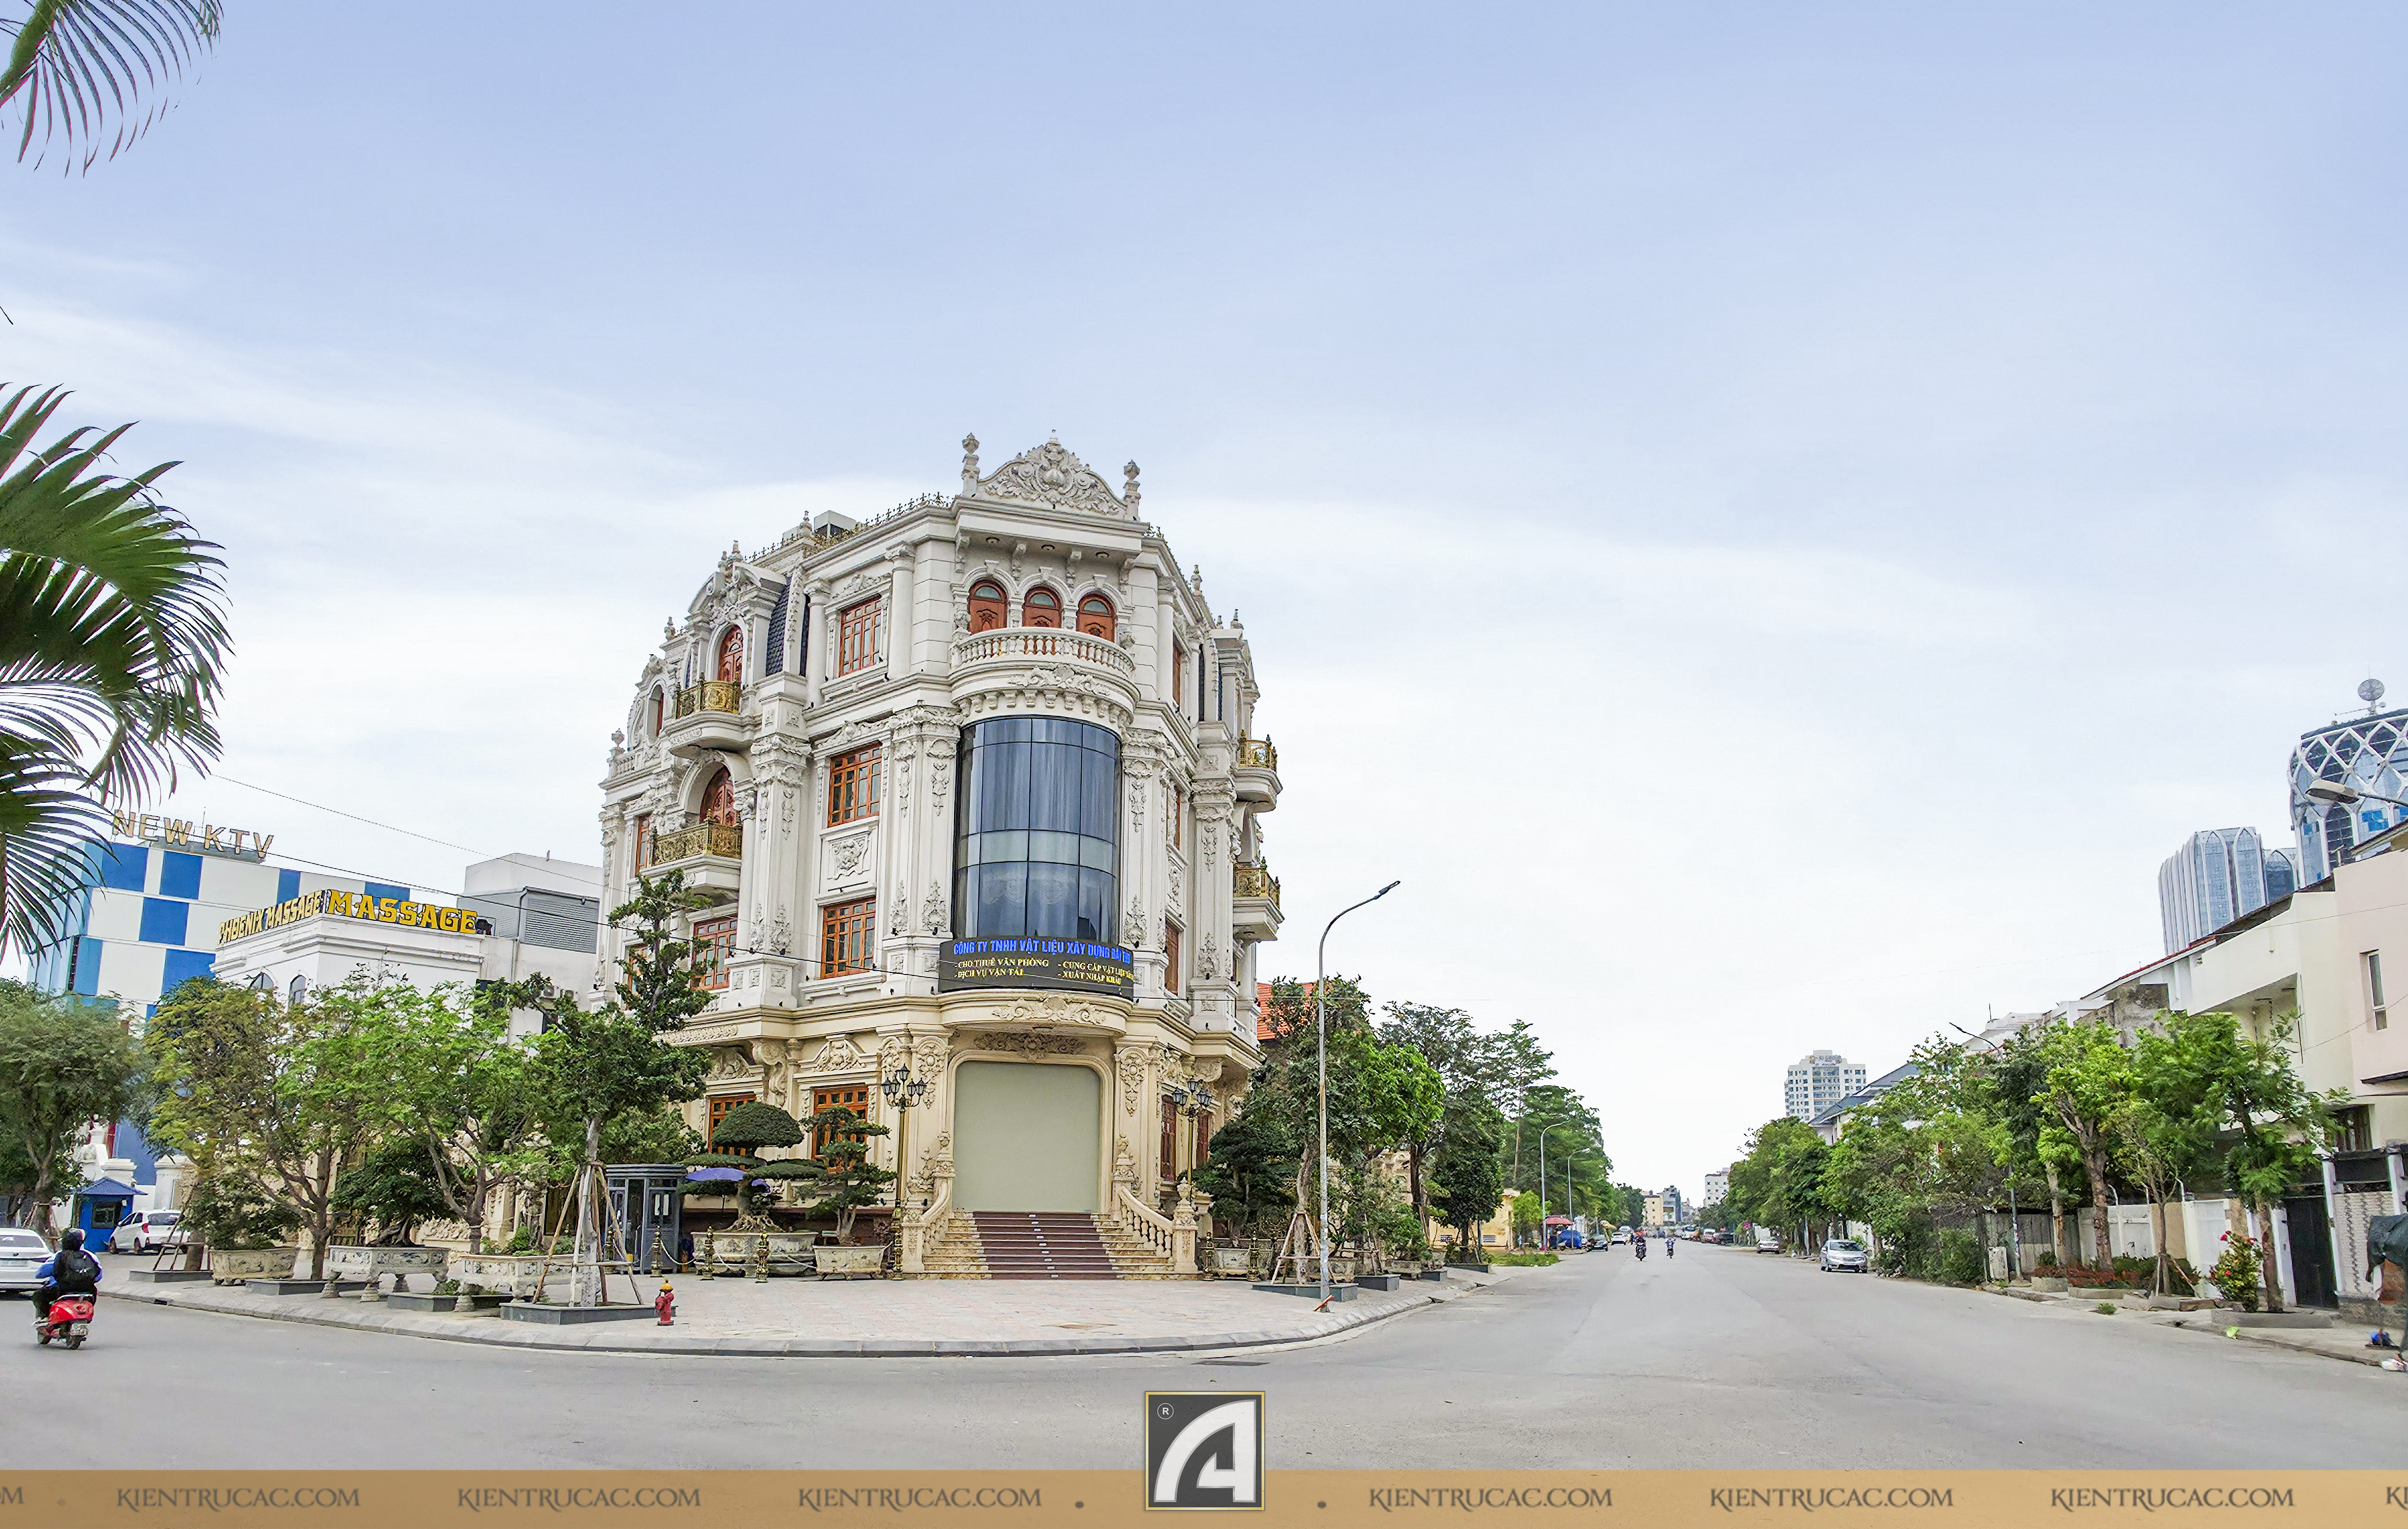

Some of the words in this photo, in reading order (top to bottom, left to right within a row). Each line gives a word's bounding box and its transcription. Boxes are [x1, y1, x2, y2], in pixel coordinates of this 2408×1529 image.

[112, 809, 192, 846] NEW
[204, 824, 274, 858] KTV
[219, 909, 265, 945] PHOENIX
[265, 890, 323, 929] MASSAGE
[327, 889, 478, 935] MASSAGE
[954, 941, 975, 955] CÔNG
[977, 941, 987, 952] TY
[990, 939, 1017, 952] TNHH
[1019, 938, 1040, 954] VẬT
[1042, 939, 1064, 955] LIỆU
[1066, 941, 1086, 955] XÂY
[974, 957, 995, 967] THUÊ
[998, 957, 1015, 966] VĂN
[1017, 957, 1049, 967] PHÒNG
[976, 968, 987, 979] VỤ
[989, 967, 1006, 978] VẬN
